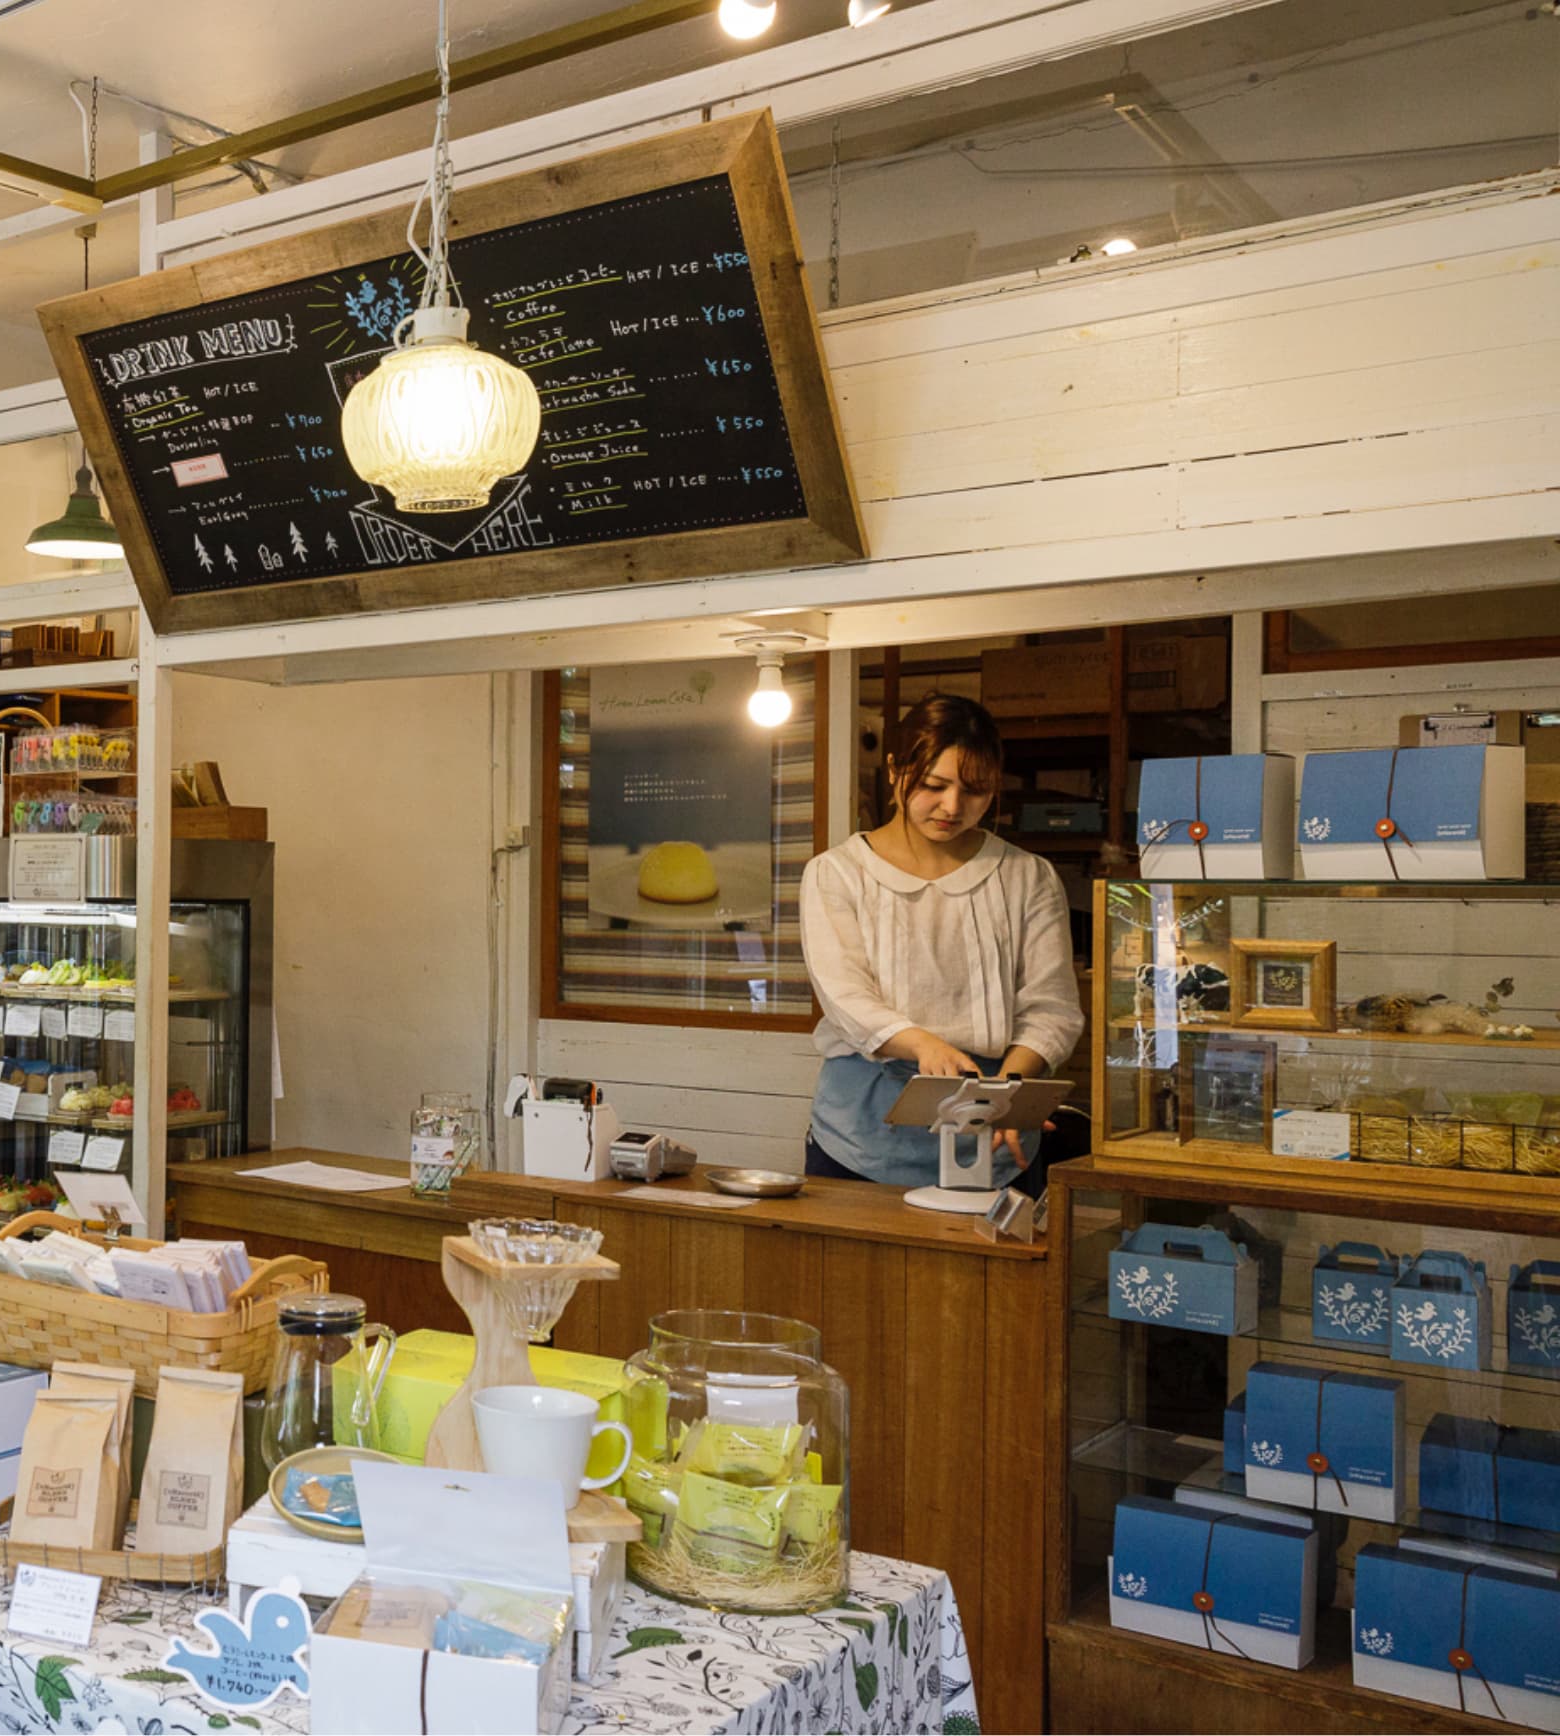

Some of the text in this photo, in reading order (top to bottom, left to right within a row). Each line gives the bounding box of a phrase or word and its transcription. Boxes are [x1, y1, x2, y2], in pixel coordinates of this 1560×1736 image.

[712, 252, 749, 273] ¥550
[506, 301, 558, 323] Coffee
[701, 304, 745, 325] ¥600
[108, 318, 283, 382] DRINK MENU
[705, 358, 752, 376] ¥650
[607, 380, 636, 397] Soda
[132, 403, 199, 430] Organic Tea
[285, 413, 323, 430] ¥700
[715, 415, 764, 433] ¥550
[296, 445, 335, 463] ¥650
[549, 443, 640, 464] Orange Juice
[563, 476, 613, 492] ミルク
[740, 466, 784, 484] ¥550
[570, 493, 614, 511] Milk
[349, 483, 554, 565] ORDER HERE
